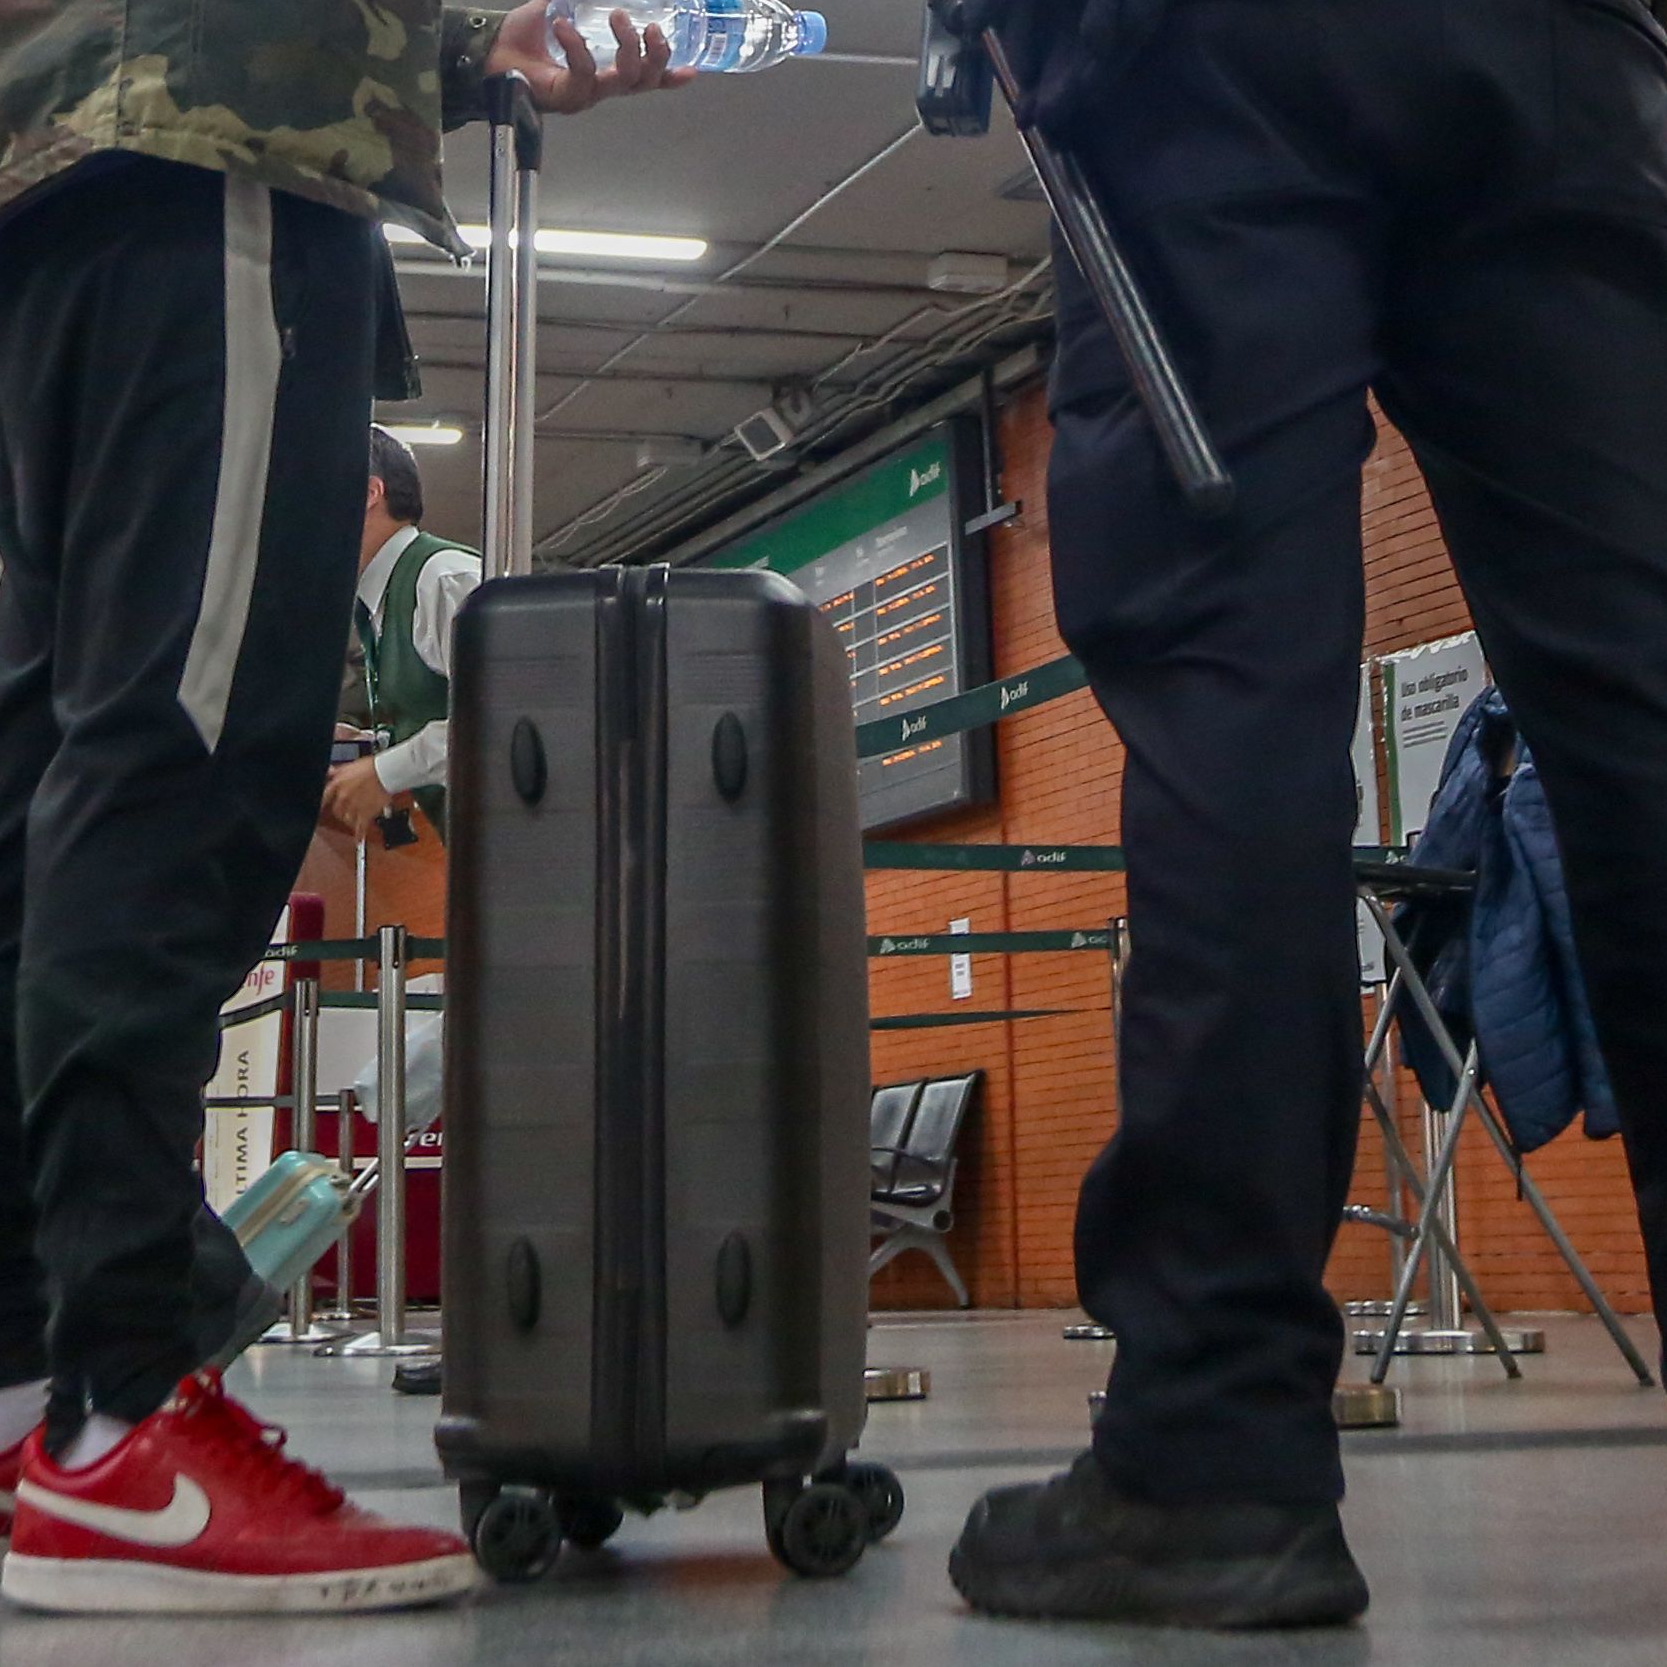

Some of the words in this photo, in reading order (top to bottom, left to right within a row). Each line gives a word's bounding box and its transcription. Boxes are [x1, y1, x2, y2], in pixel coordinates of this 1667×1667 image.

[1419, 665, 1468, 693] obligatorio
[1401, 707, 1412, 722] de
[1414, 693, 1460, 717] mascarilla
[1036, 851, 1067, 864] adif
[264, 944, 300, 958] adif
[896, 937, 931, 951] adif
[247, 963, 275, 996] nfe
[236, 1127, 249, 1195] LTIMA
